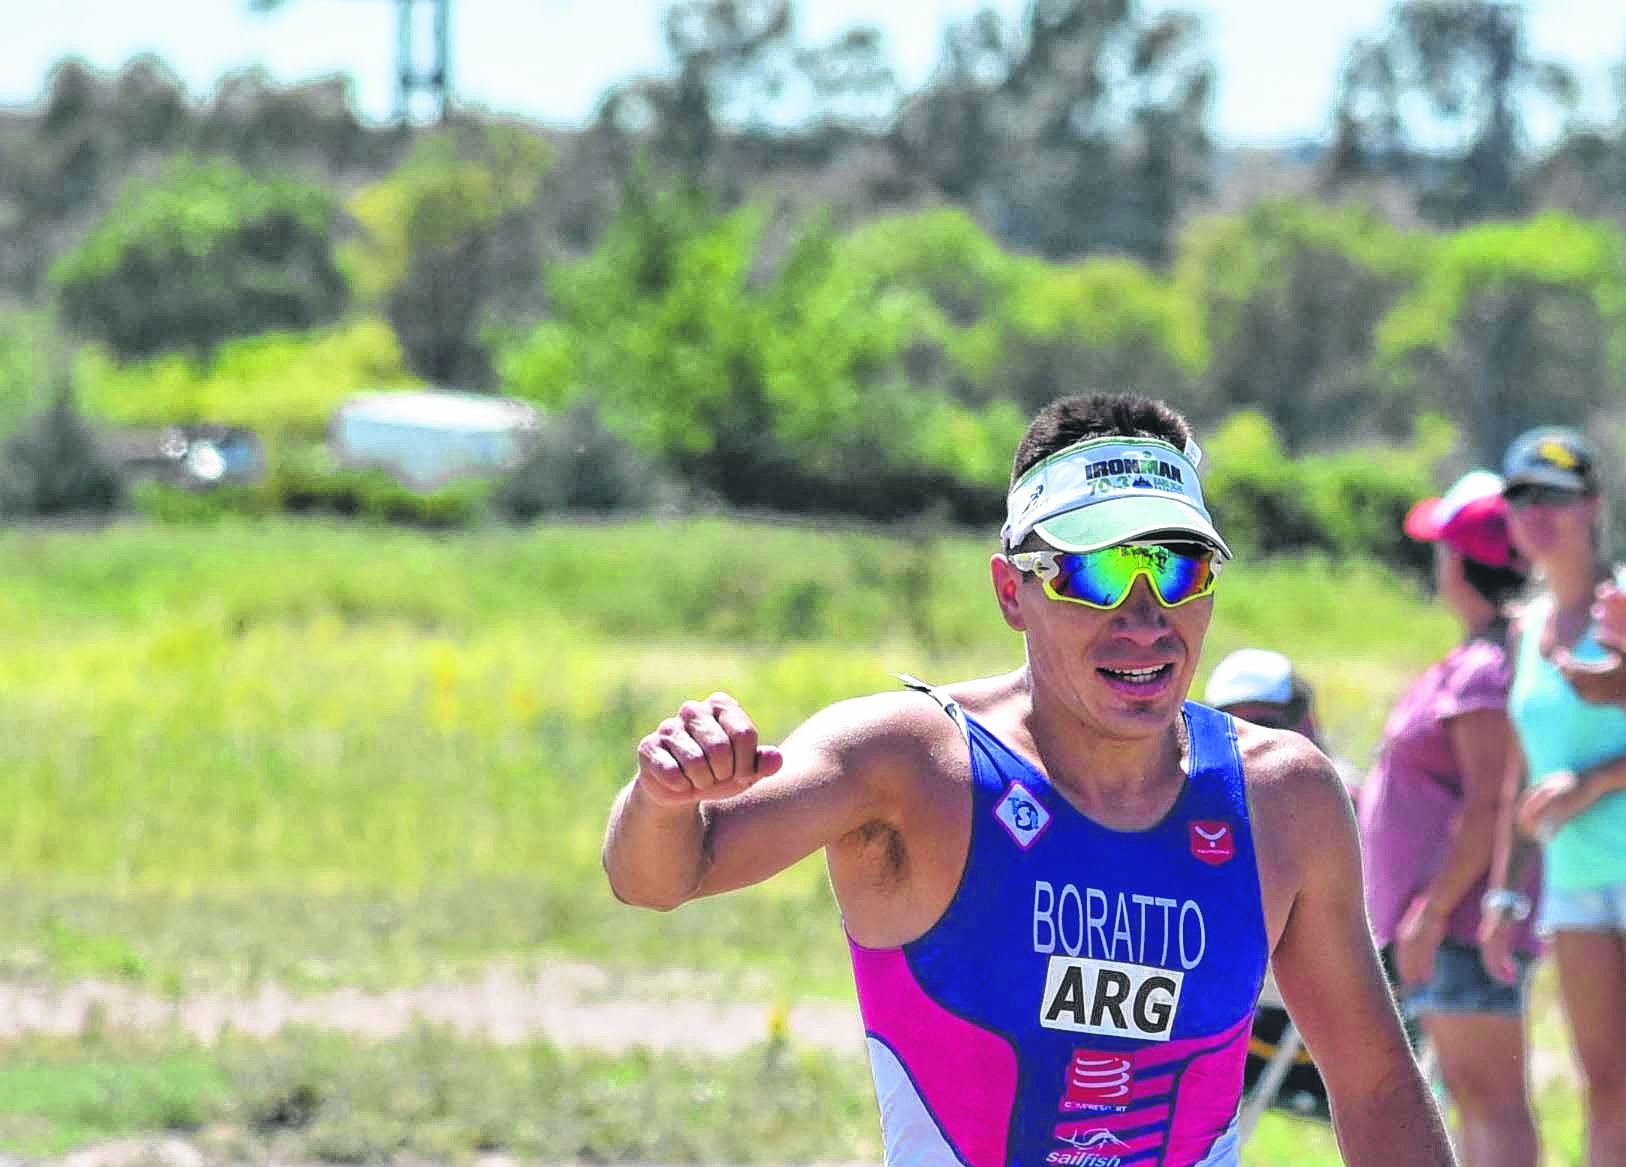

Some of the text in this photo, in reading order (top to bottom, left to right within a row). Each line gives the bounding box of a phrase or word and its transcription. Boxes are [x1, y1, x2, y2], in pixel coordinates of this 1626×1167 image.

[1085, 453, 1184, 484] IRONMAN
[1088, 476, 1131, 496] 70.3
[1033, 880, 1206, 969] BORATTO
[1046, 966, 1177, 1033] ARG
